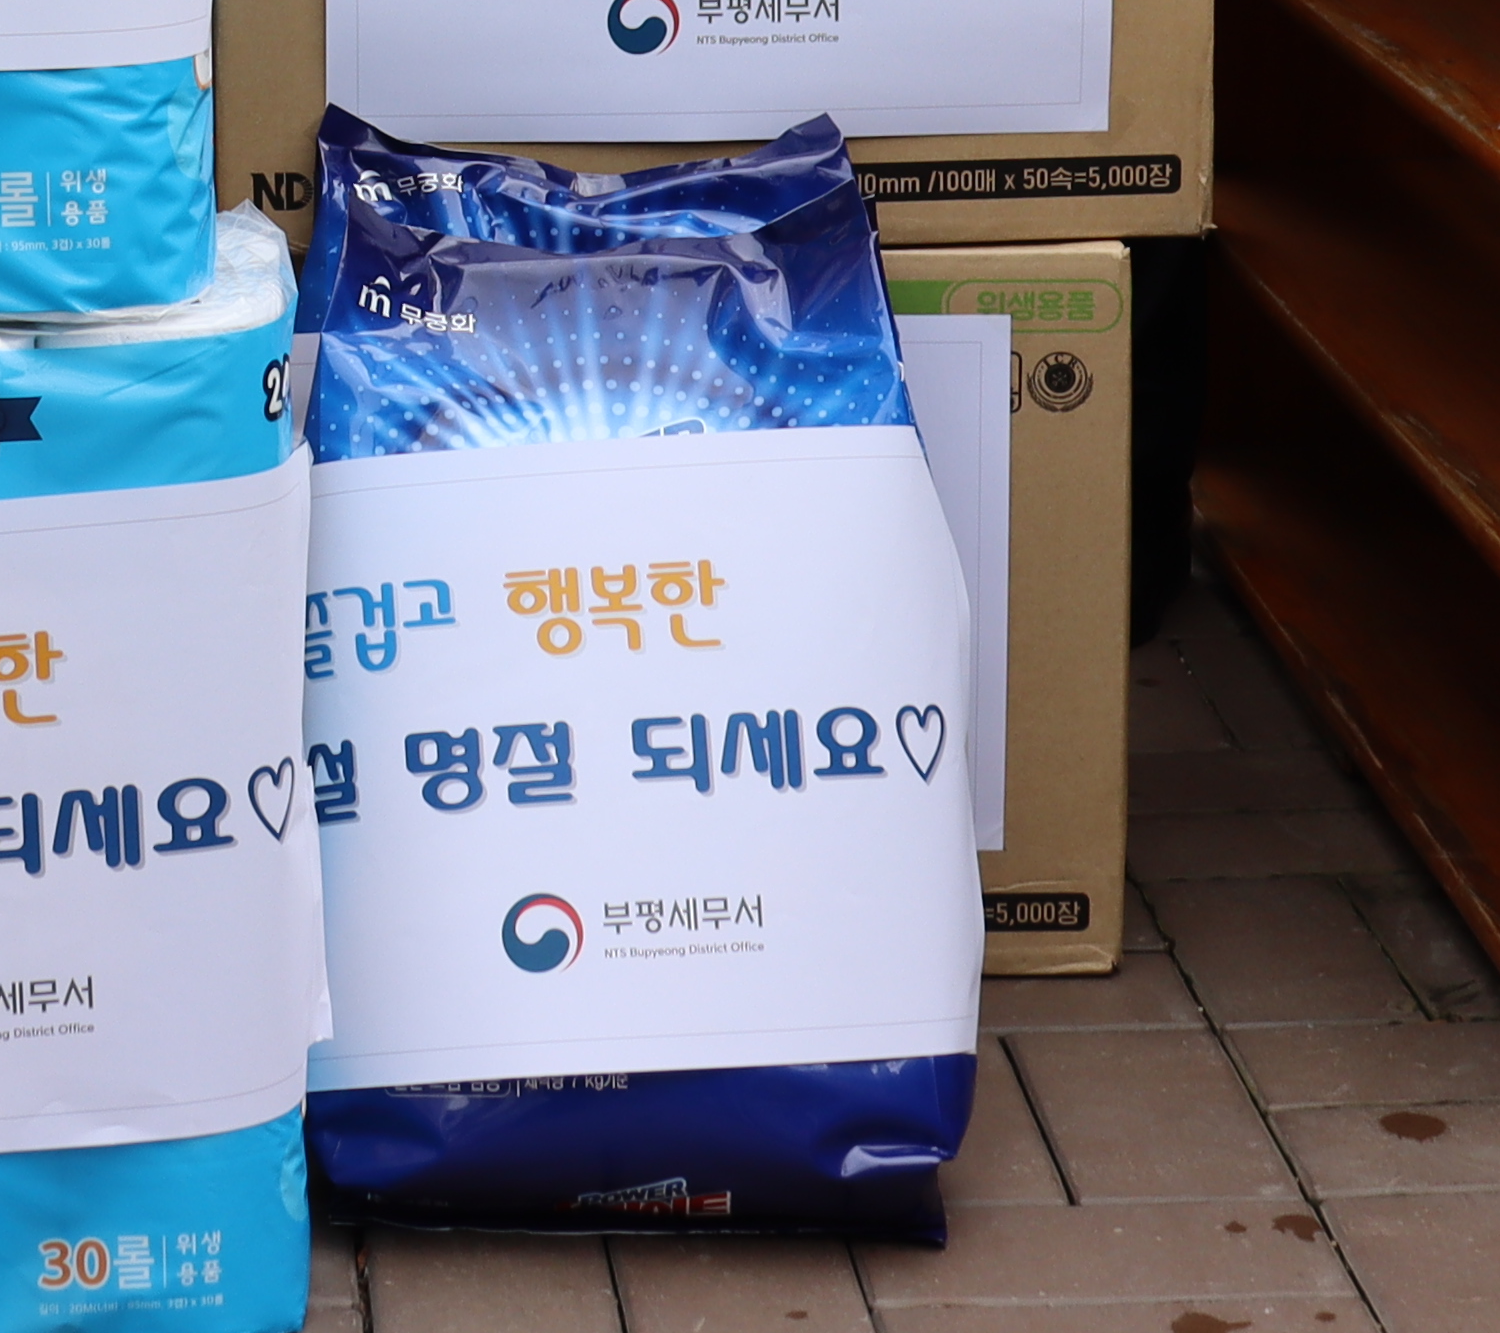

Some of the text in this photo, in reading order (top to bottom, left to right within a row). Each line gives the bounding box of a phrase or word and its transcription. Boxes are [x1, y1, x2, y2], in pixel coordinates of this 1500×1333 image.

[696, 33, 839, 46] NTS Bupyeong District Office
[60, 169, 107, 194] 위생
[397, 172, 463, 194] 무궁화
[928, 169, 996, 194] /100매
[61, 200, 109, 226] 용품
[400, 303, 476, 333] 무궁화
[503, 559, 727, 657] 행복한
[405, 720, 577, 813] 명절
[603, 894, 764, 934] 부평세무서
[604, 941, 765, 959] NTS Bupyeong District Office
[13, 1026, 54, 1039] District
[58, 1023, 95, 1034] Office
[177, 1230, 221, 1256] 위생
[37, 1235, 155, 1290] 30롤
[177, 1260, 222, 1286] 용품
